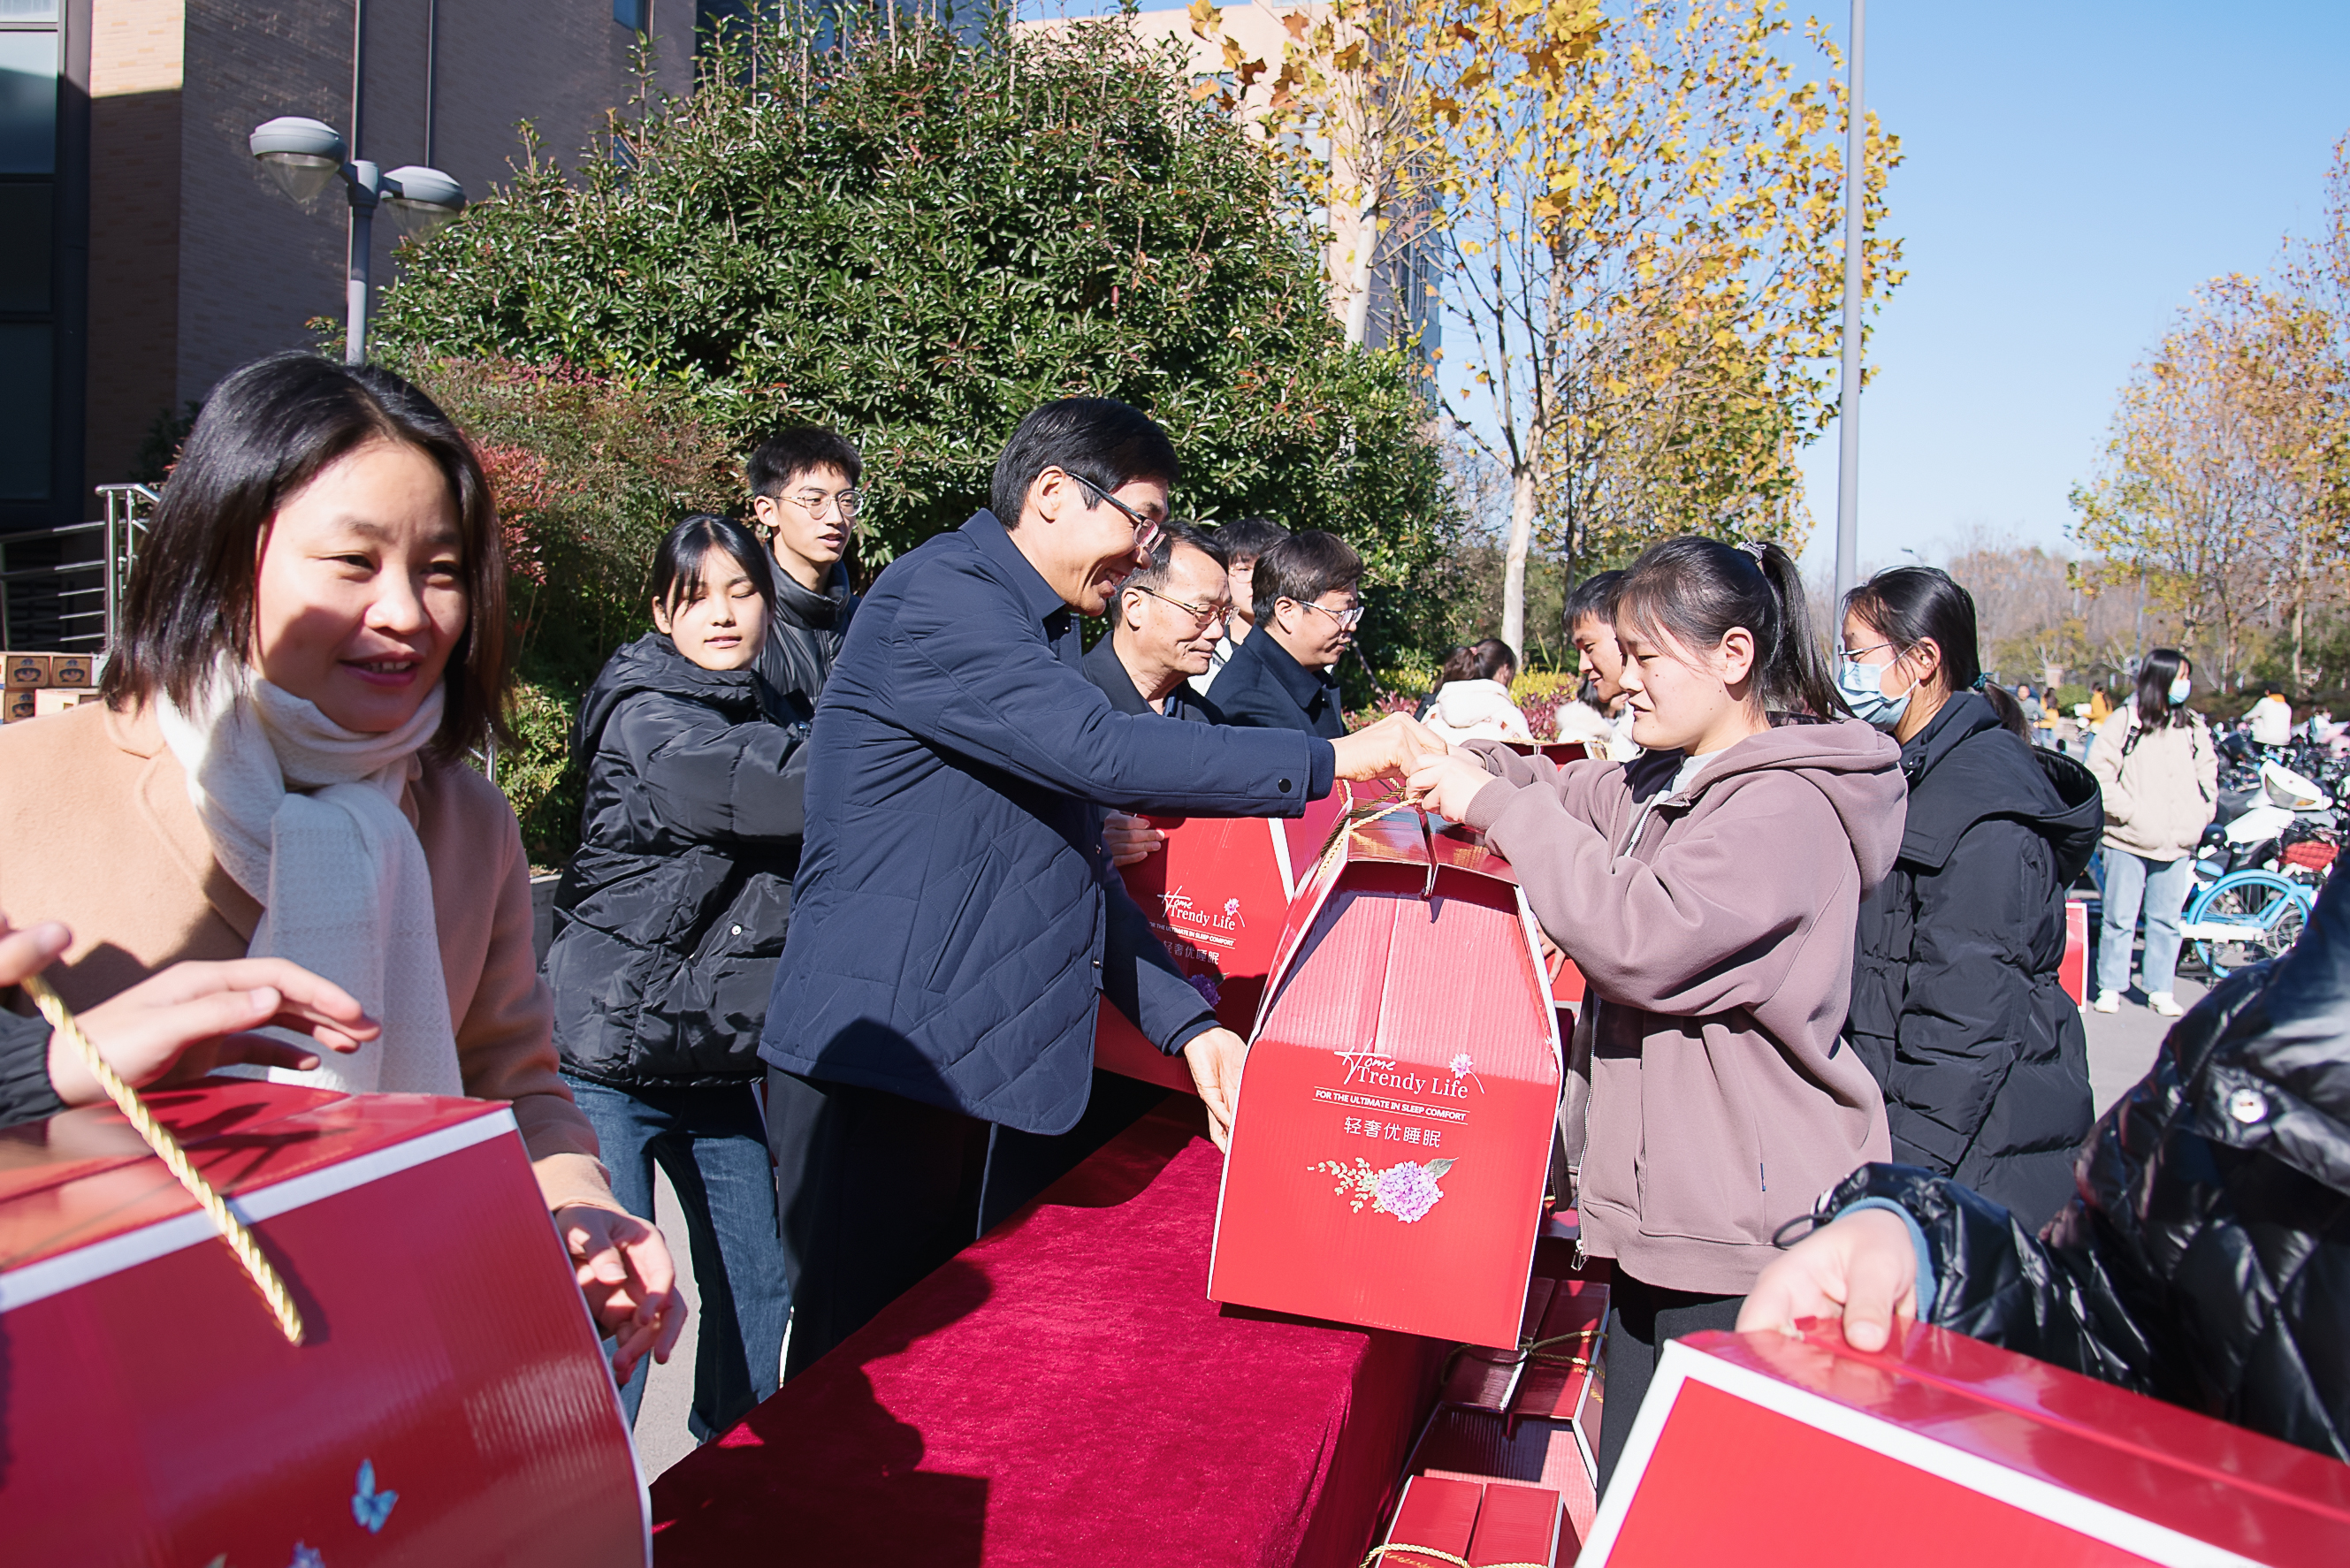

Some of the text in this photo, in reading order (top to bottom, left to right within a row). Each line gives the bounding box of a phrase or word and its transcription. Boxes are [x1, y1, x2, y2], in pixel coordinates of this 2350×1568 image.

[1157, 886, 1193, 917] Home
[1170, 904, 1235, 931] Trendy Life
[1166, 925, 1188, 936] ULTIMATE
[1194, 932, 1209, 940] SLEEP
[1209, 935, 1234, 947] COMFORT
[1333, 1037, 1396, 1085] Home
[1357, 1065, 1469, 1099] Trendy Life
[1315, 1090, 1331, 1100] FOR
[1333, 1092, 1349, 1102] THE
[1350, 1095, 1390, 1109] ULTIMATE
[1401, 1104, 1424, 1114] SLEEP
[1425, 1107, 1466, 1121] COMFORT
[1343, 1115, 1441, 1148] 轻奢优睡眠
